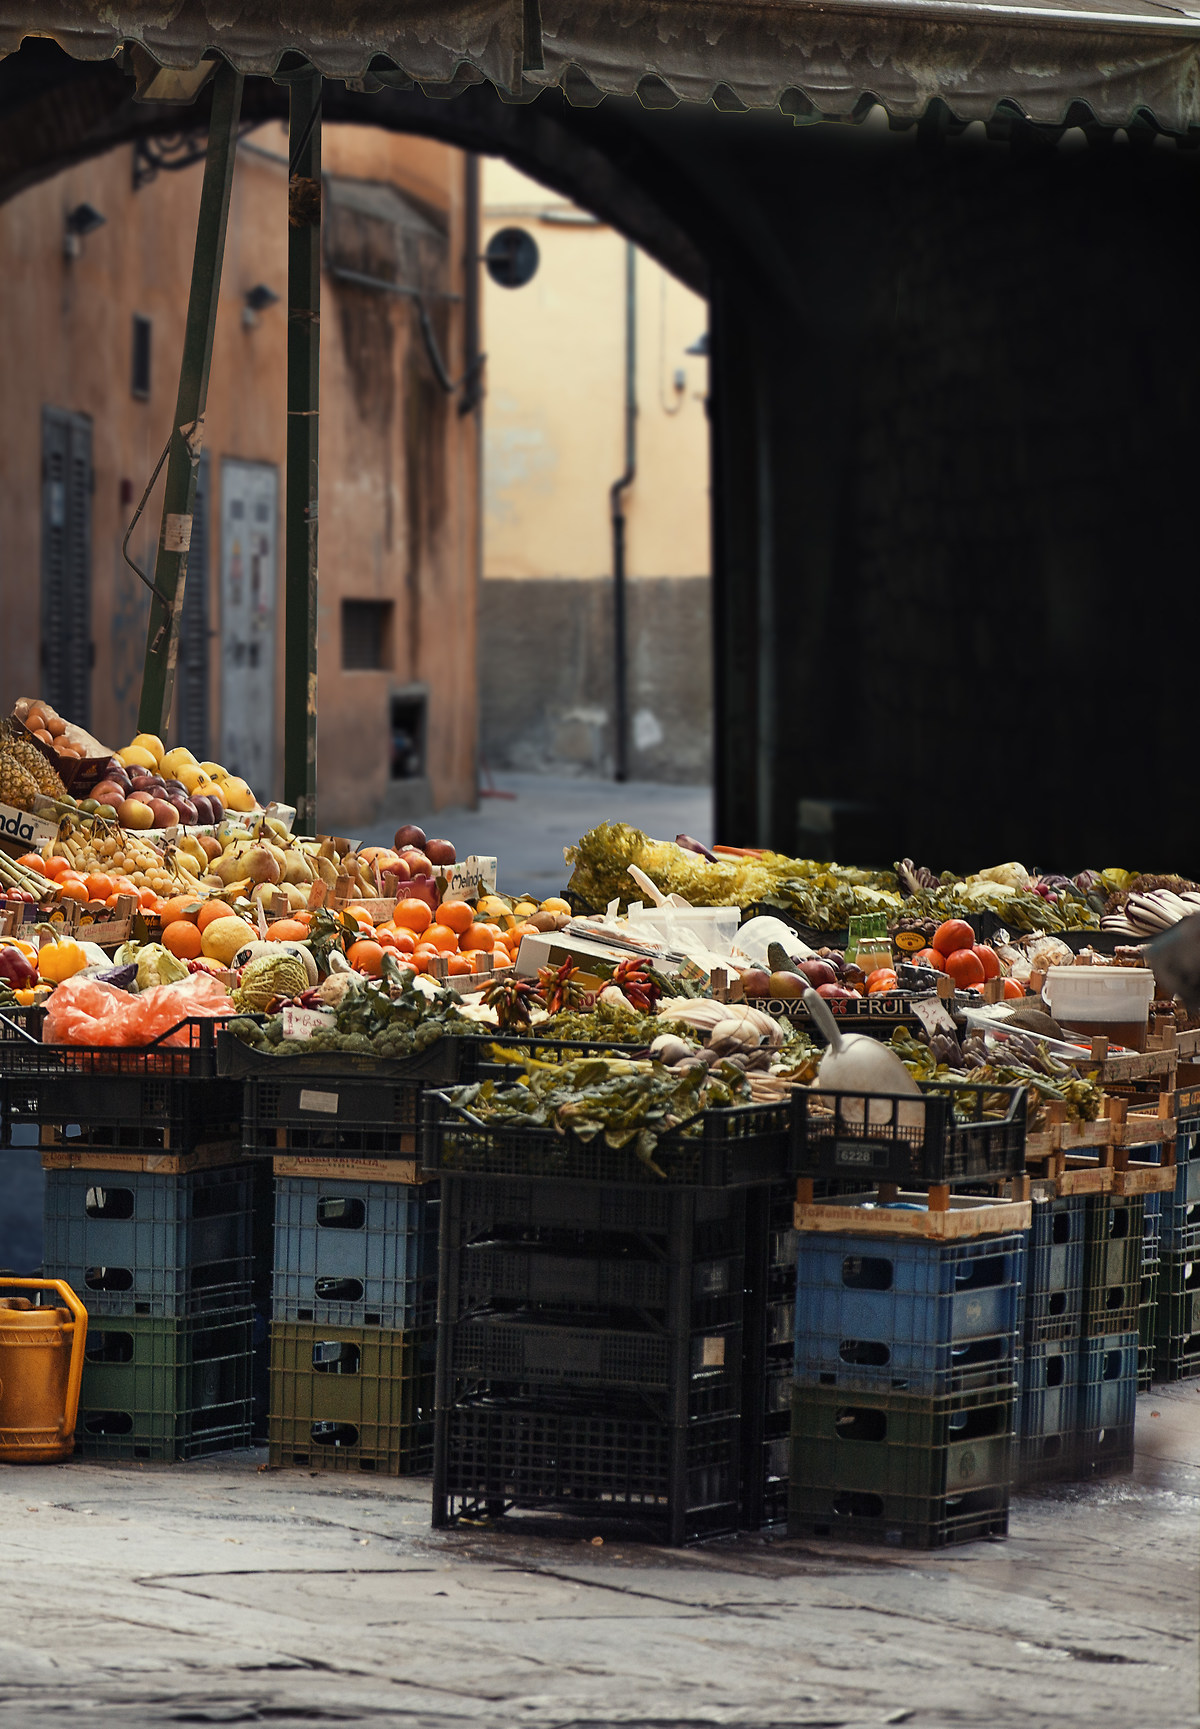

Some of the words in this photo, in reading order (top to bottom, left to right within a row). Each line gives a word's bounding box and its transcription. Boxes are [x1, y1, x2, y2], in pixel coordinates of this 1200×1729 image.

[754, 999, 811, 1015] ROYA
[856, 999, 919, 1015] FRUIT
[841, 1150, 871, 1162] 6228
